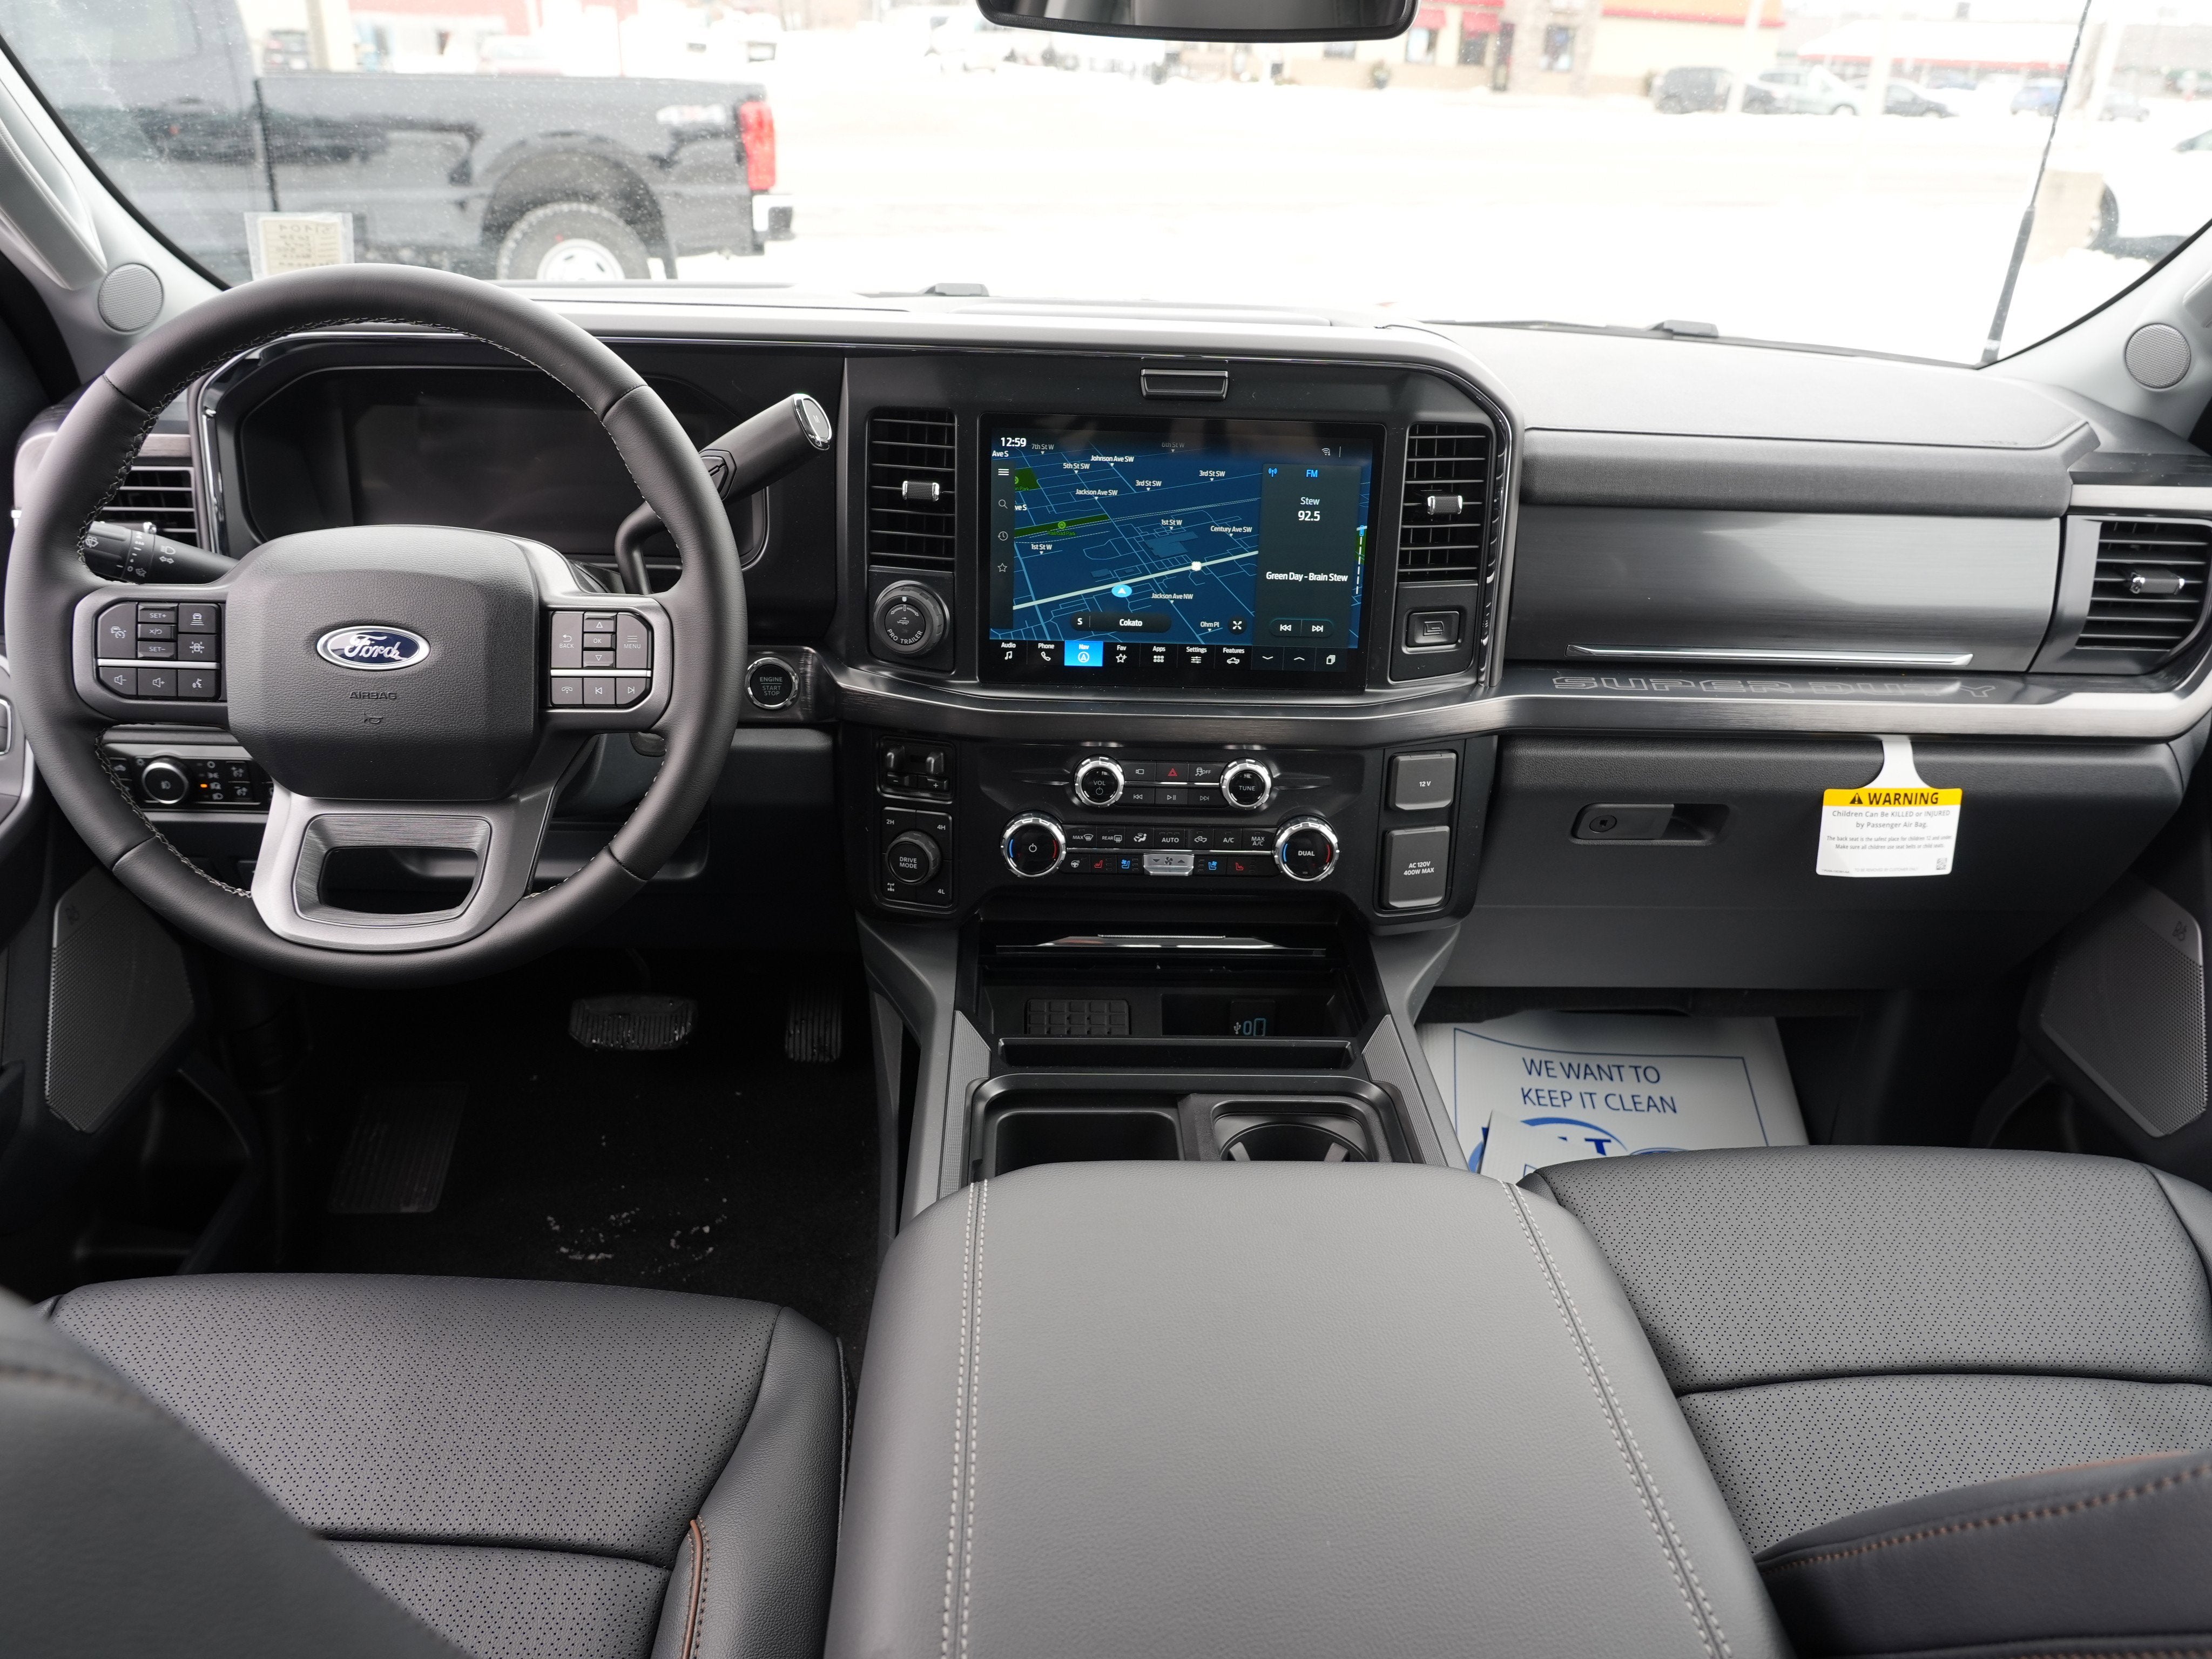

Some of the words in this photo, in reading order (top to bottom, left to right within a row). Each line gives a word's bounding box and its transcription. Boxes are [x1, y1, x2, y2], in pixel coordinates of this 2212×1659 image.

[1001, 437, 1027, 447] 12:59
[1306, 469, 1318, 477] FM
[1300, 496, 1320, 505] Stew
[1298, 510, 1320, 521] 92.5
[1266, 571, 1287, 579] Green
[1289, 572, 1303, 582] Day
[1309, 573, 1327, 581] Brain
[1329, 574, 1348, 582] Stew
[887, 629, 898, 640] PRO
[900, 631, 923, 644] TRAILER
[344, 634, 408, 660] Ford
[1552, 677, 1795, 693] SUPER
[1809, 682, 1995, 697] DUTY
[349, 691, 397, 700] AIRBAG
[1868, 793, 1939, 805] WARNING
[1521, 1057, 1557, 1079] WE
[1560, 1061, 1626, 1082] WANT
[1629, 1064, 1661, 1083] TO
[1521, 1087, 1572, 1108] KEEP
[1580, 1092, 1597, 1109] IT
[1604, 1093, 1677, 1114] CLEAN
